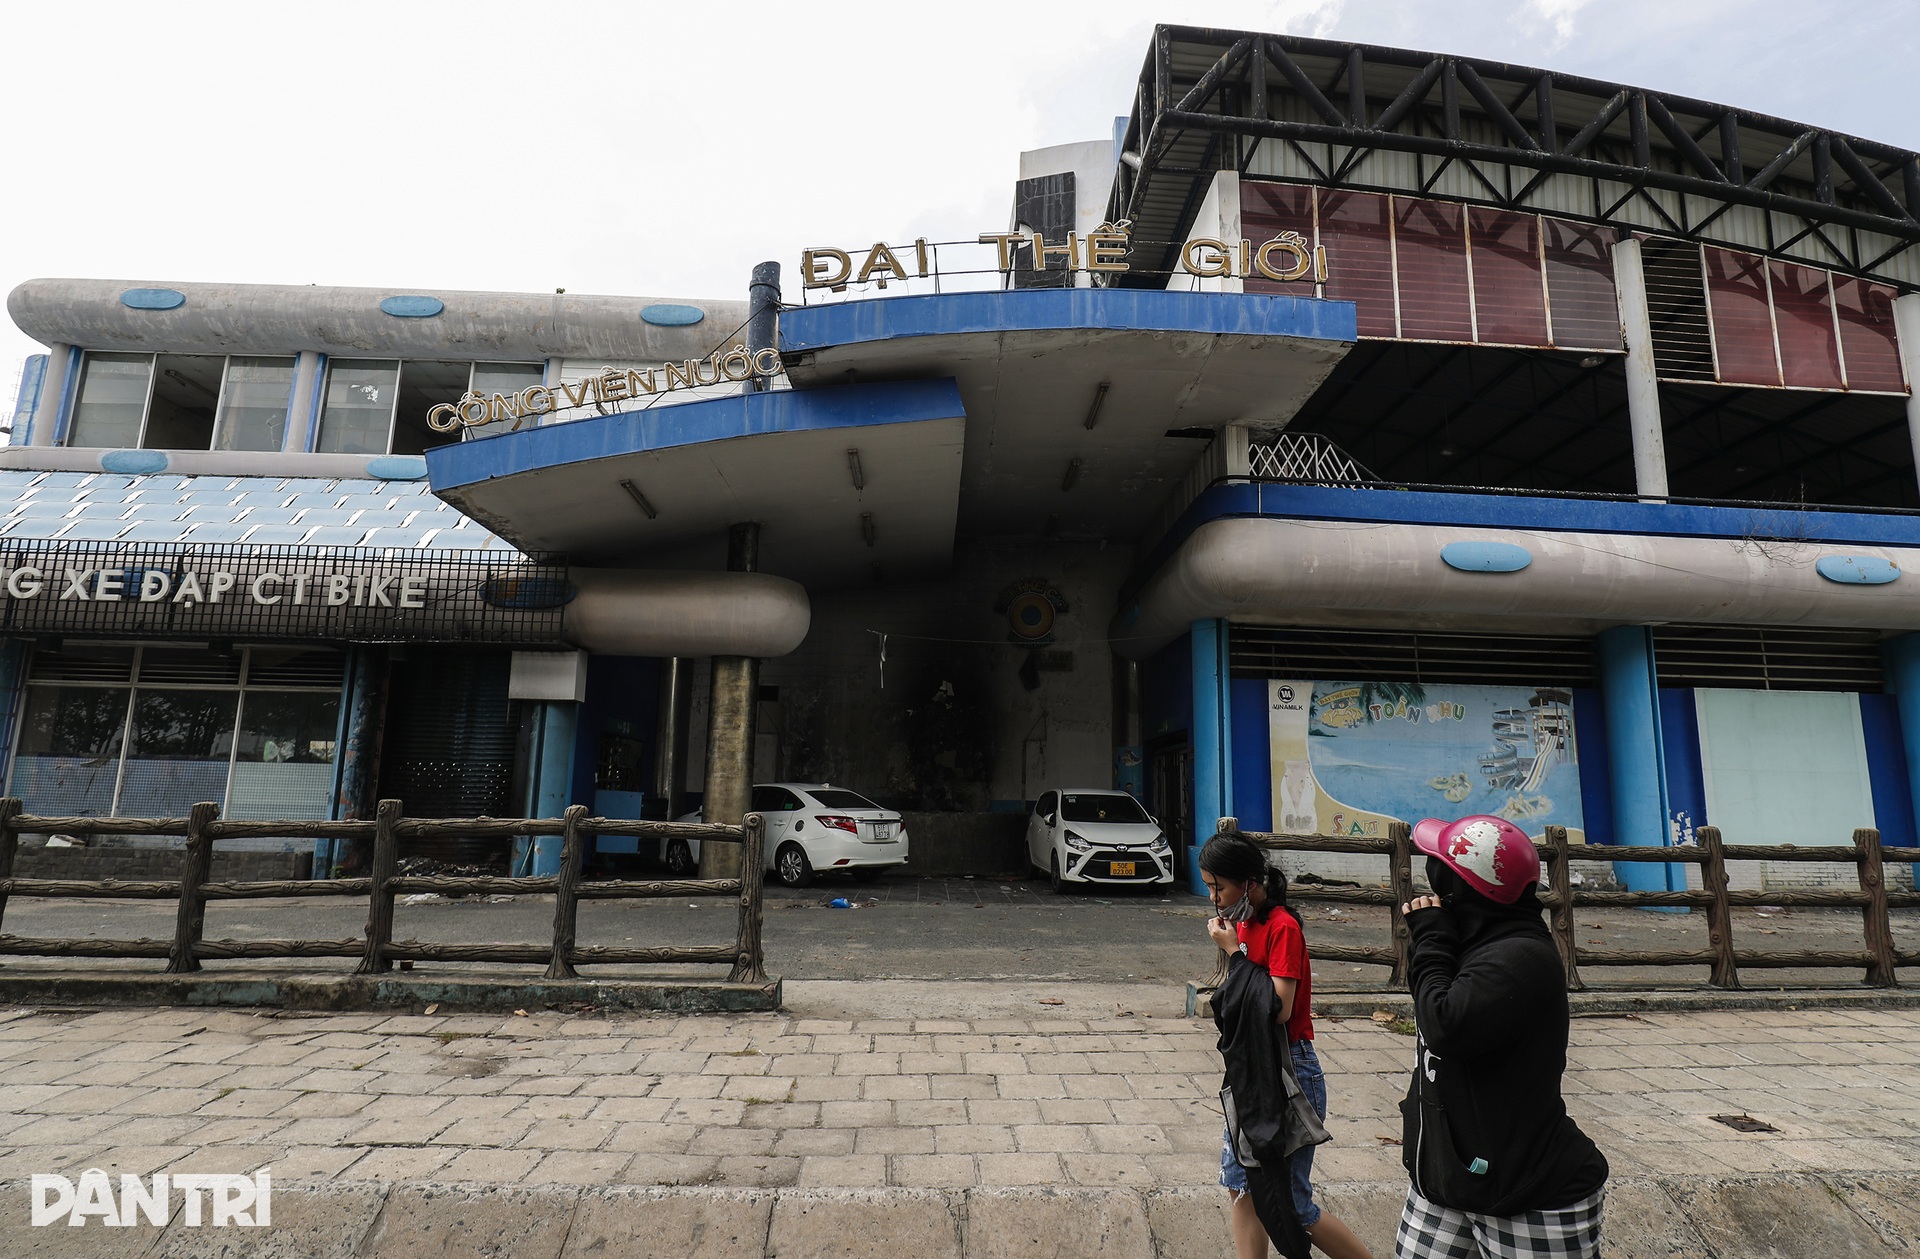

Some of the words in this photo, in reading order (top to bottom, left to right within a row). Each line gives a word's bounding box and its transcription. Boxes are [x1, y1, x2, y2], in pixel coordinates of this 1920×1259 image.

[800, 237, 929, 292] ĐẠI
[978, 219, 1133, 273] THẾ
[1181, 231, 1329, 283] GIỚI
[426, 384, 556, 432] CÔNG
[559, 365, 657, 407] VIÊN
[663, 344, 785, 390] NƯỚC
[0, 566, 44, 599] G
[59, 568, 124, 601] XE
[141, 571, 237, 608] ĐẠP
[252, 573, 312, 606] CT
[327, 574, 428, 608] BIKE
